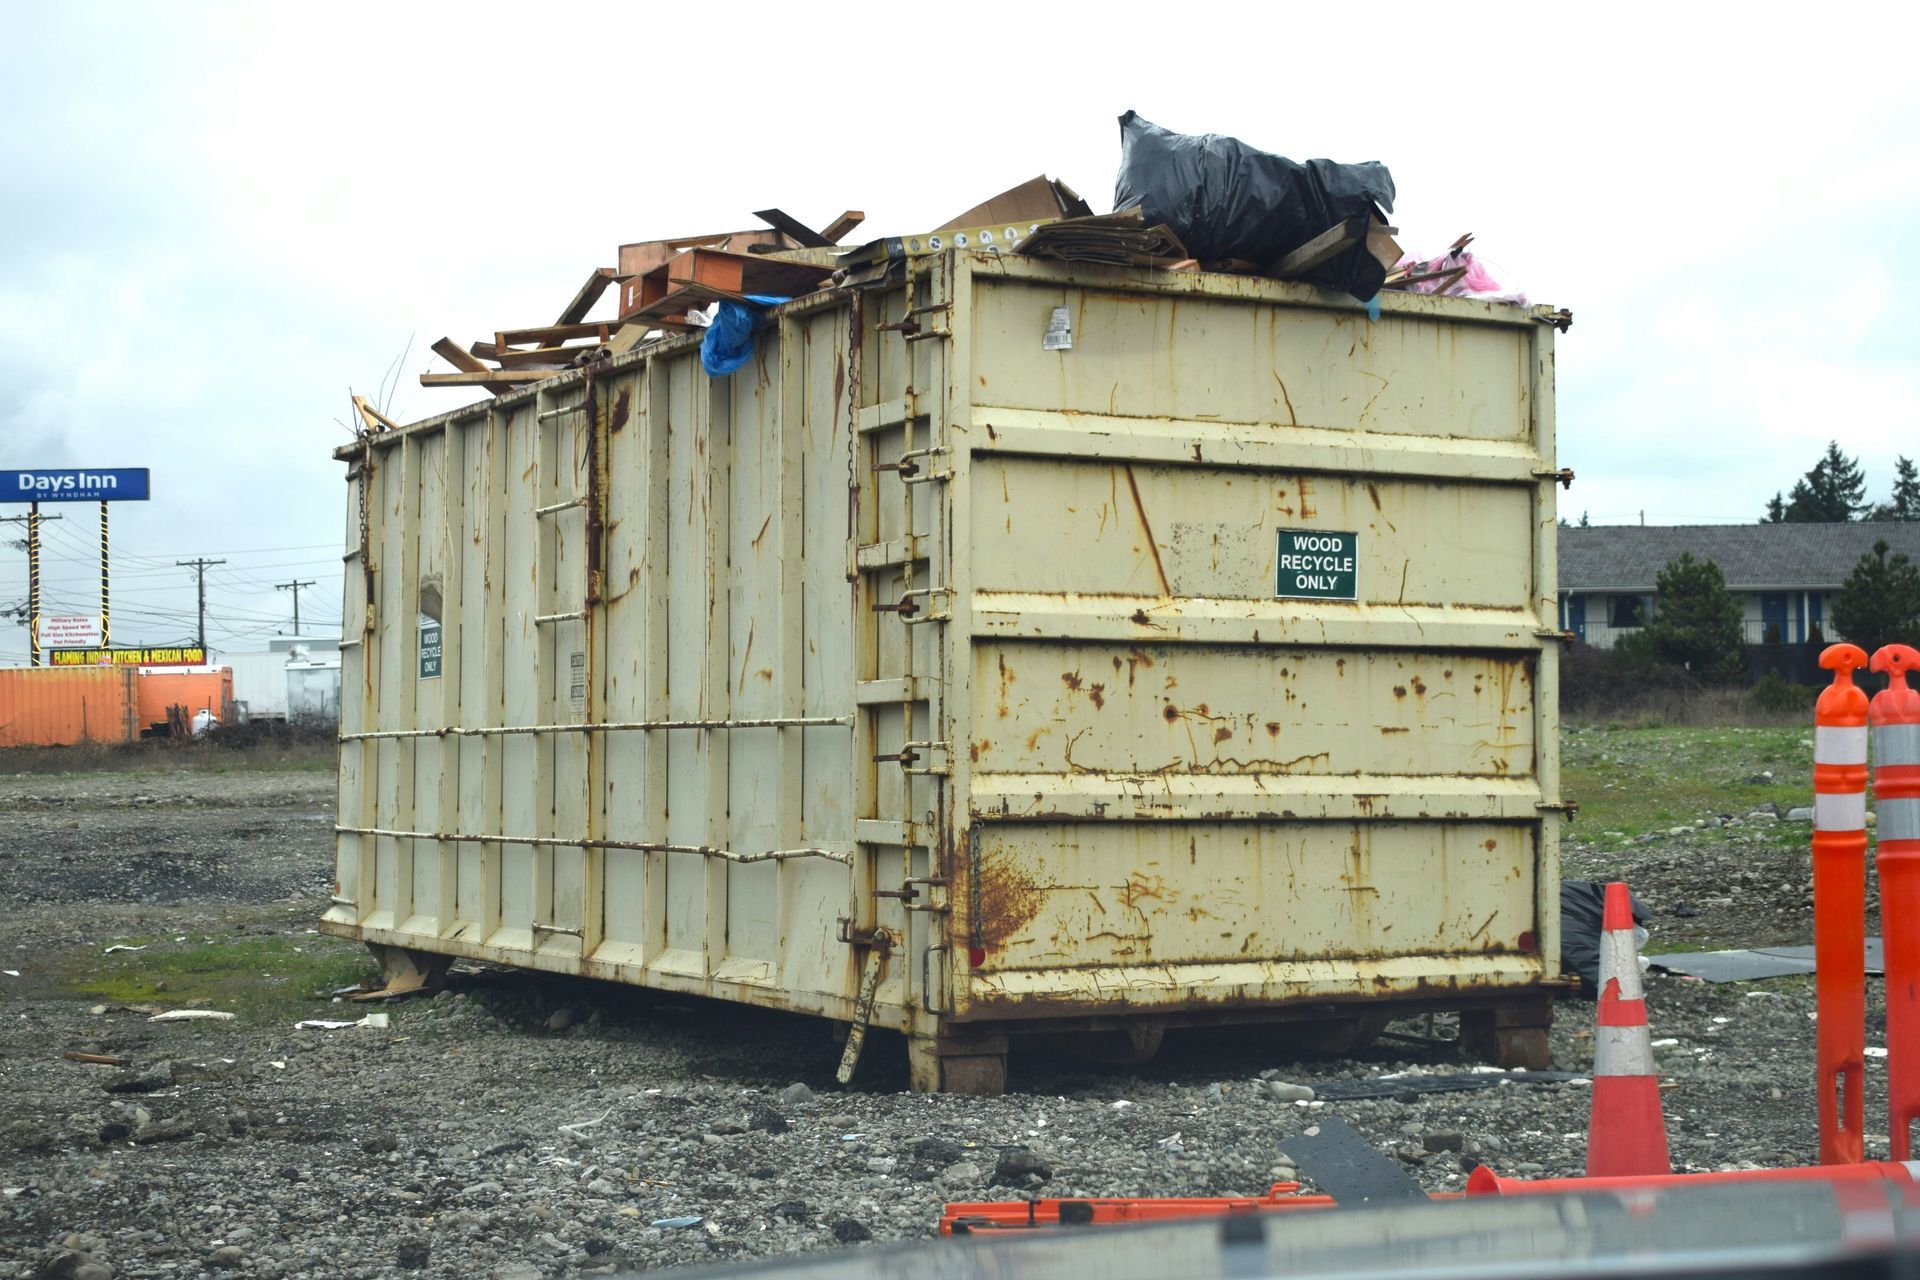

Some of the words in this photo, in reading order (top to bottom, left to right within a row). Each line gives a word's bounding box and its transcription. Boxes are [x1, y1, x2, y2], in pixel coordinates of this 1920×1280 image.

[18, 474, 75, 492] Days
[79, 472, 117, 488] Inn
[1293, 536, 1342, 552] WOOD
[1281, 554, 1353, 572] RECYCLE
[1295, 574, 1338, 590] ONLY
[424, 632, 438, 644] WOOD
[54, 651, 84, 664] FLAMING
[112, 650, 142, 664] KITCHEN
[143, 650, 150, 664] &
[151, 648, 182, 663] MEXICAN
[183, 648, 203, 662] FOOD
[422, 646, 441, 659] RECYCLE
[424, 661, 438, 672] ONLY
